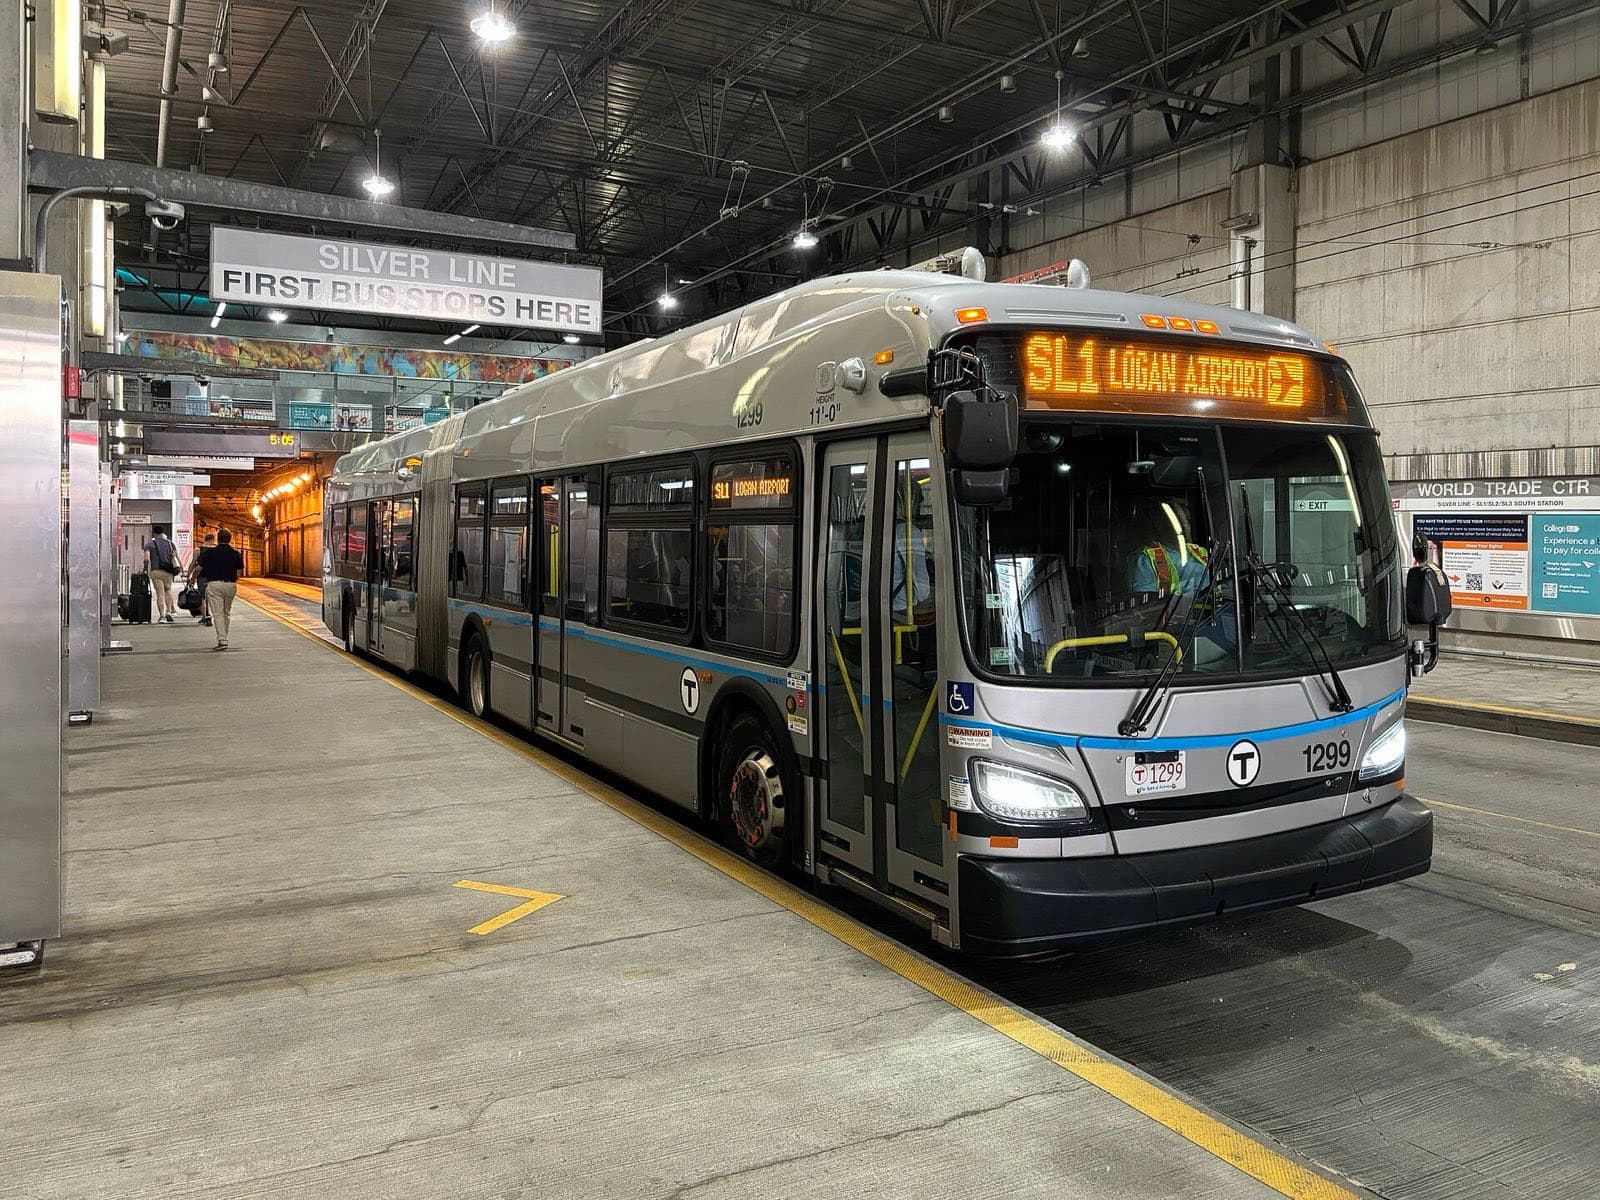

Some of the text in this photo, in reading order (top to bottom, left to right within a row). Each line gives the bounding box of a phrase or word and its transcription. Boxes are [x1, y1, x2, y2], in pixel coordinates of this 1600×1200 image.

[318, 243, 517, 288] SILVER LINE
[223, 269, 591, 326] FIRST BUS STOPS HERE
[1026, 334, 1267, 399] SL1 LOGAN AIRPORT
[816, 393, 835, 404] HEIGHT
[736, 402, 763, 428] 1299
[270, 434, 294, 446] 5:05
[714, 478, 790, 499] SL1 LOGAN AIRPORT
[1417, 479, 1590, 497] WORLD TRADE CTR
[1309, 501, 1328, 510] EXIT
[1543, 536, 1589, 546] Experience
[1543, 546, 1552, 554] to
[1553, 547, 1569, 556] pay
[1570, 546, 1582, 554] for
[954, 727, 990, 737] WARNING
[1303, 740, 1351, 773] 1299
[1150, 762, 1183, 784] 1299
